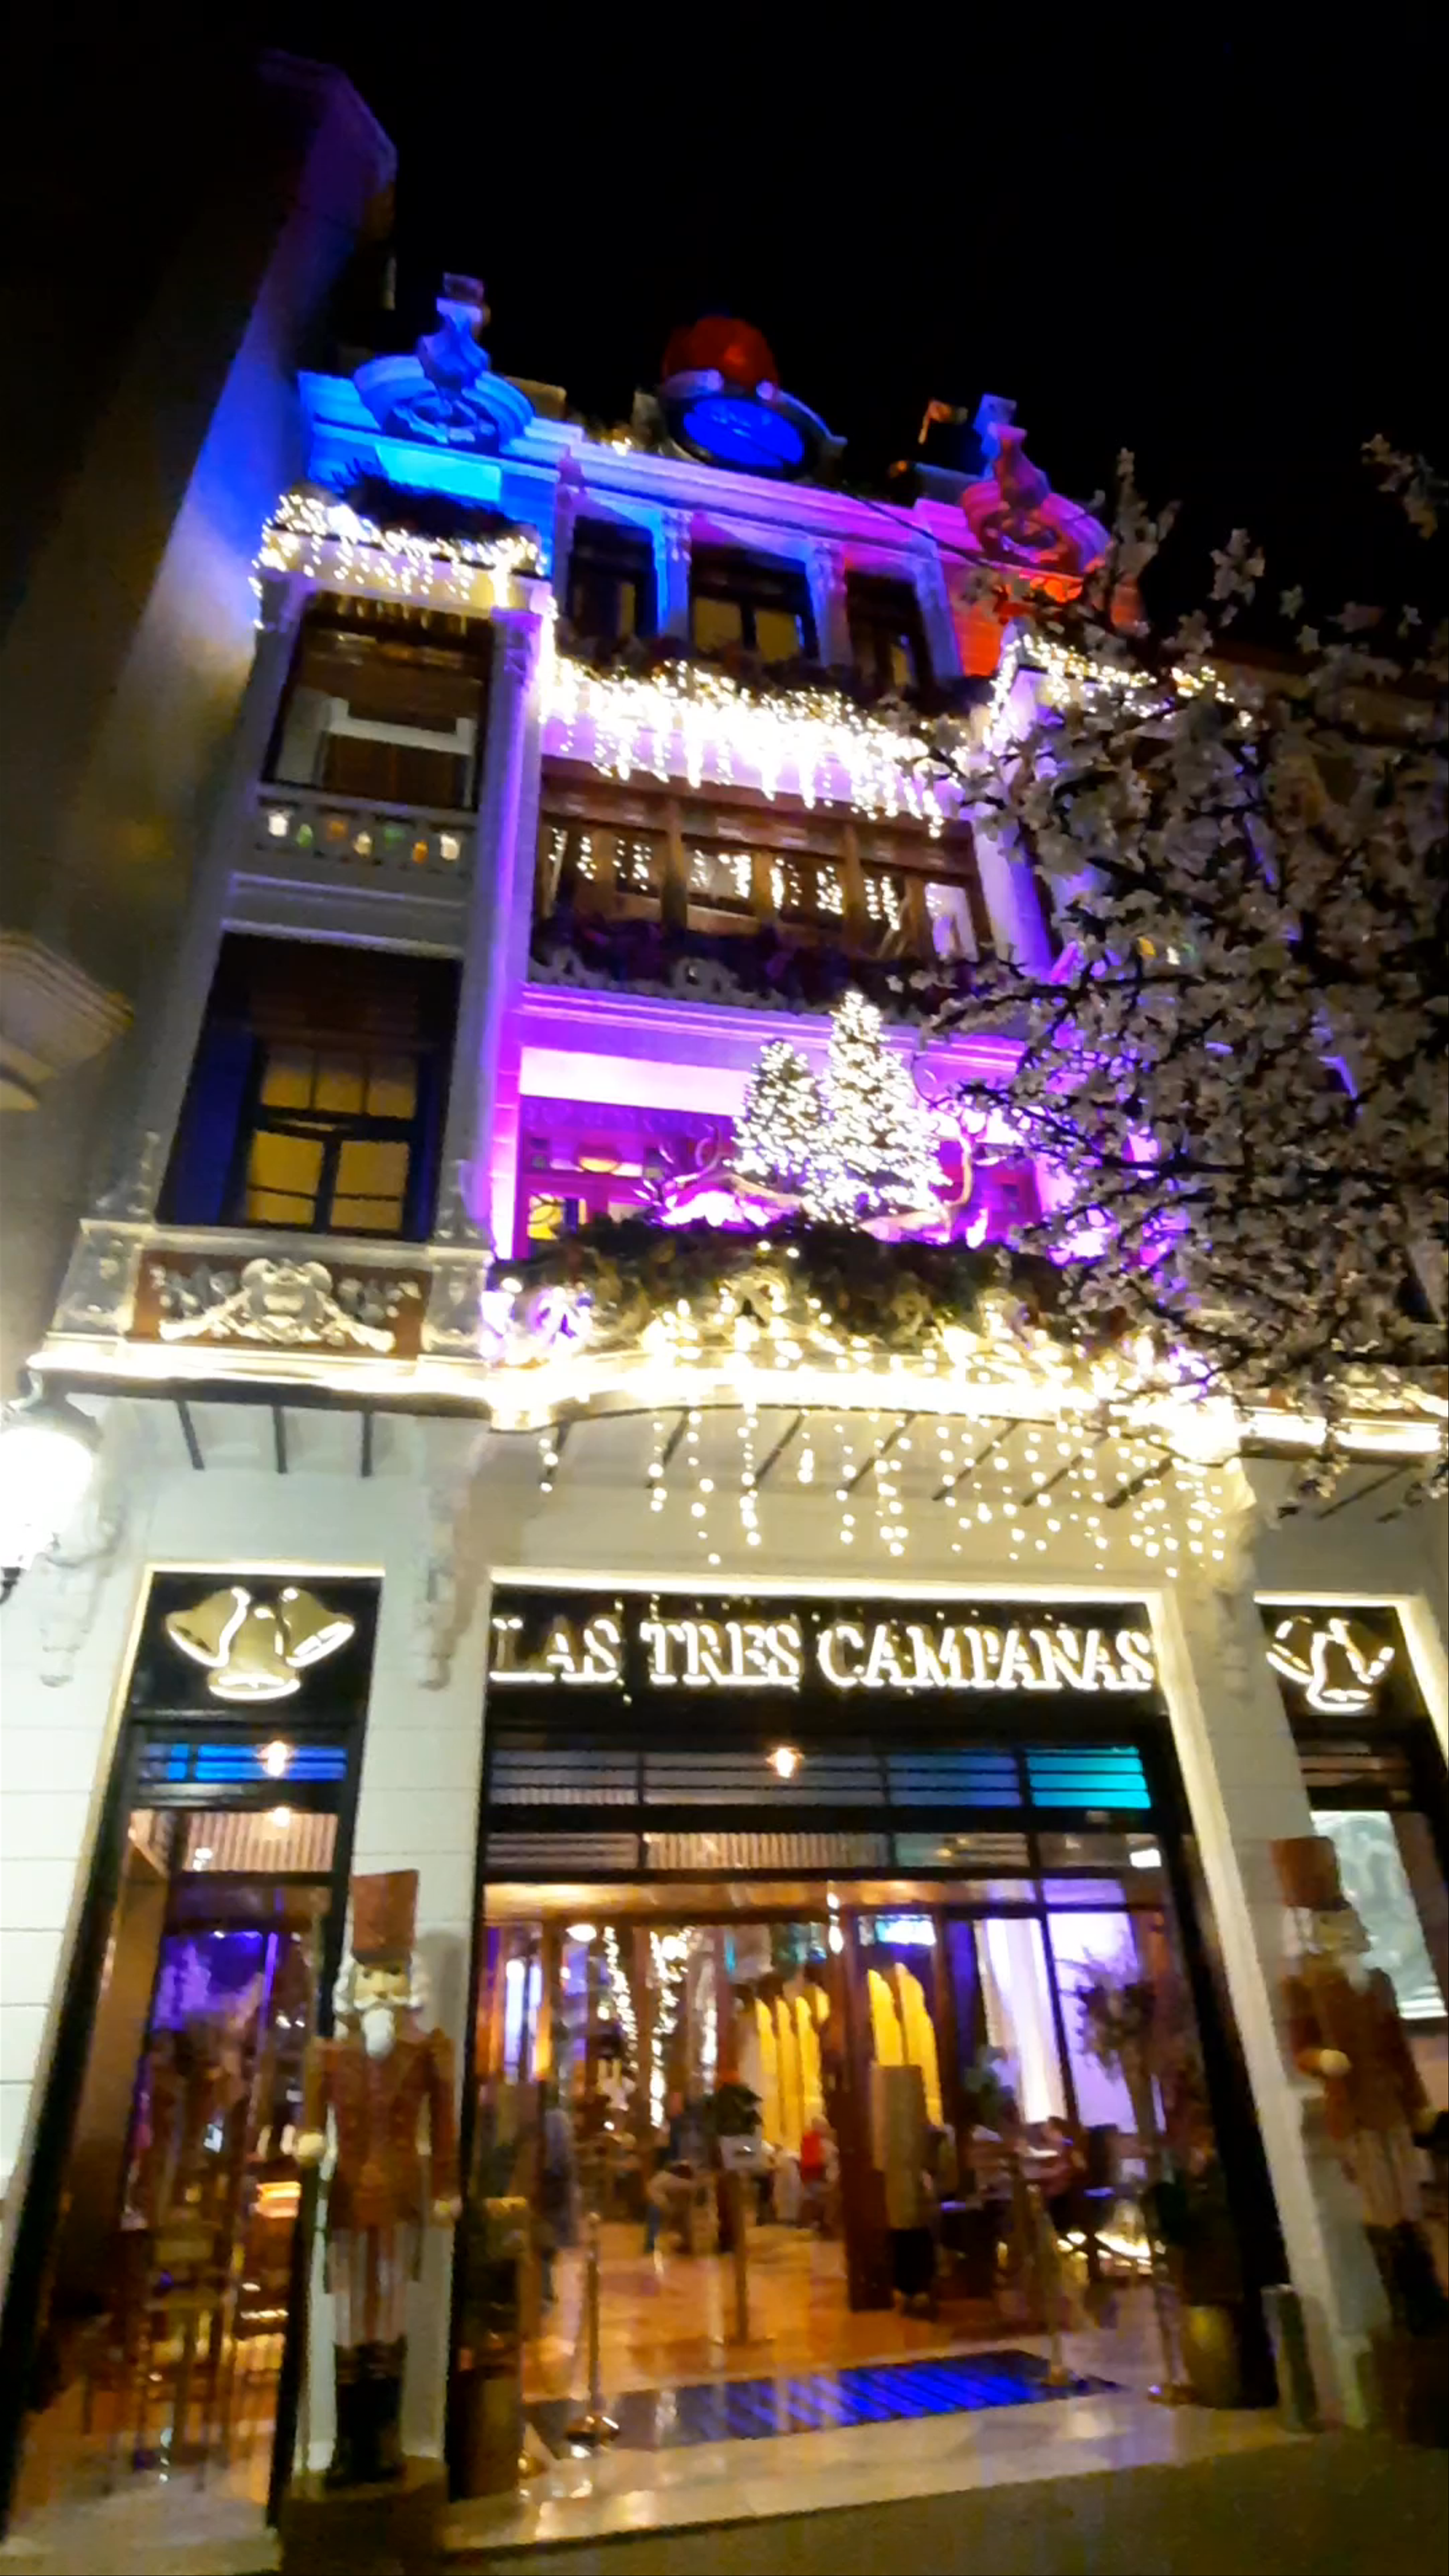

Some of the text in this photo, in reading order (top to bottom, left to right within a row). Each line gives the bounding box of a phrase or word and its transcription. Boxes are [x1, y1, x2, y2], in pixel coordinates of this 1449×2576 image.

[489, 1615, 1155, 1691] LAS TRES CAMPANAS
